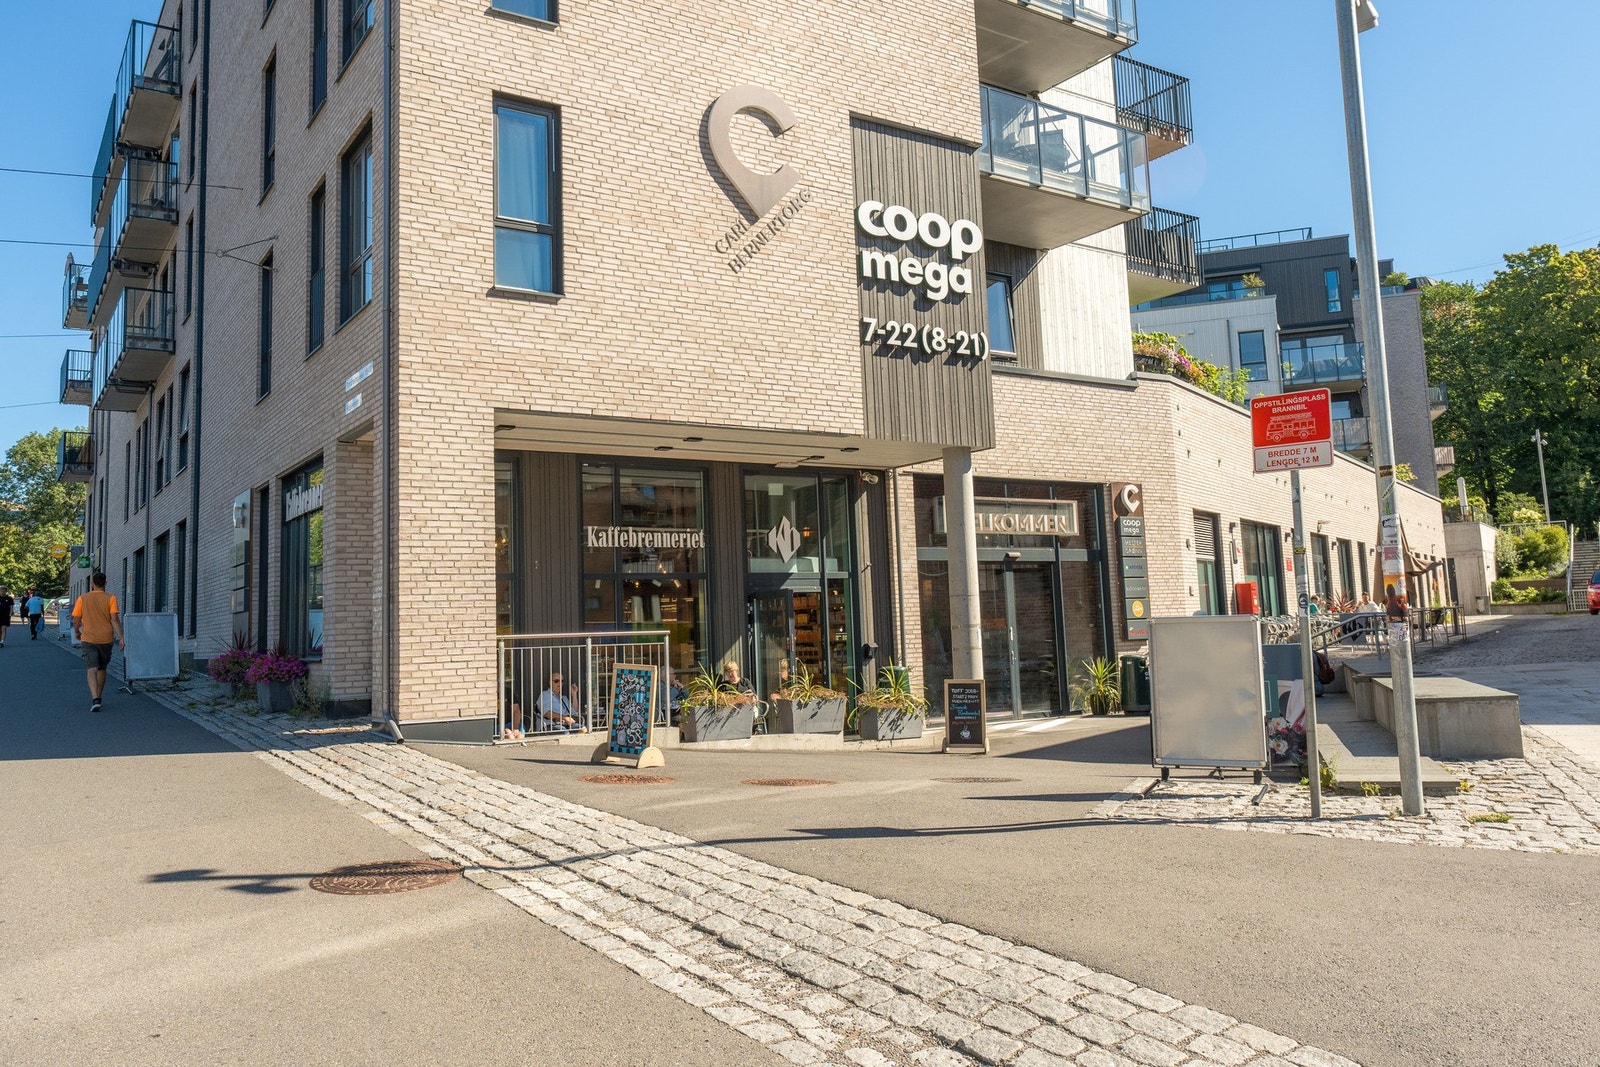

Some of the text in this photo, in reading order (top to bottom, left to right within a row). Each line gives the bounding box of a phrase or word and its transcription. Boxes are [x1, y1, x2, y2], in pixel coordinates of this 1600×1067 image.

[714, 219, 749, 254] CARL
[856, 200, 983, 260] coop
[860, 250, 973, 301] mega
[1253, 394, 1326, 409] OPPSTILLINGSPLASS
[1272, 404, 1308, 413] BRANNBIL
[1266, 458, 1299, 467] LENGDE
[1267, 448, 1301, 458] BREDDE
[586, 525, 705, 549] Kaffebrenneriet
